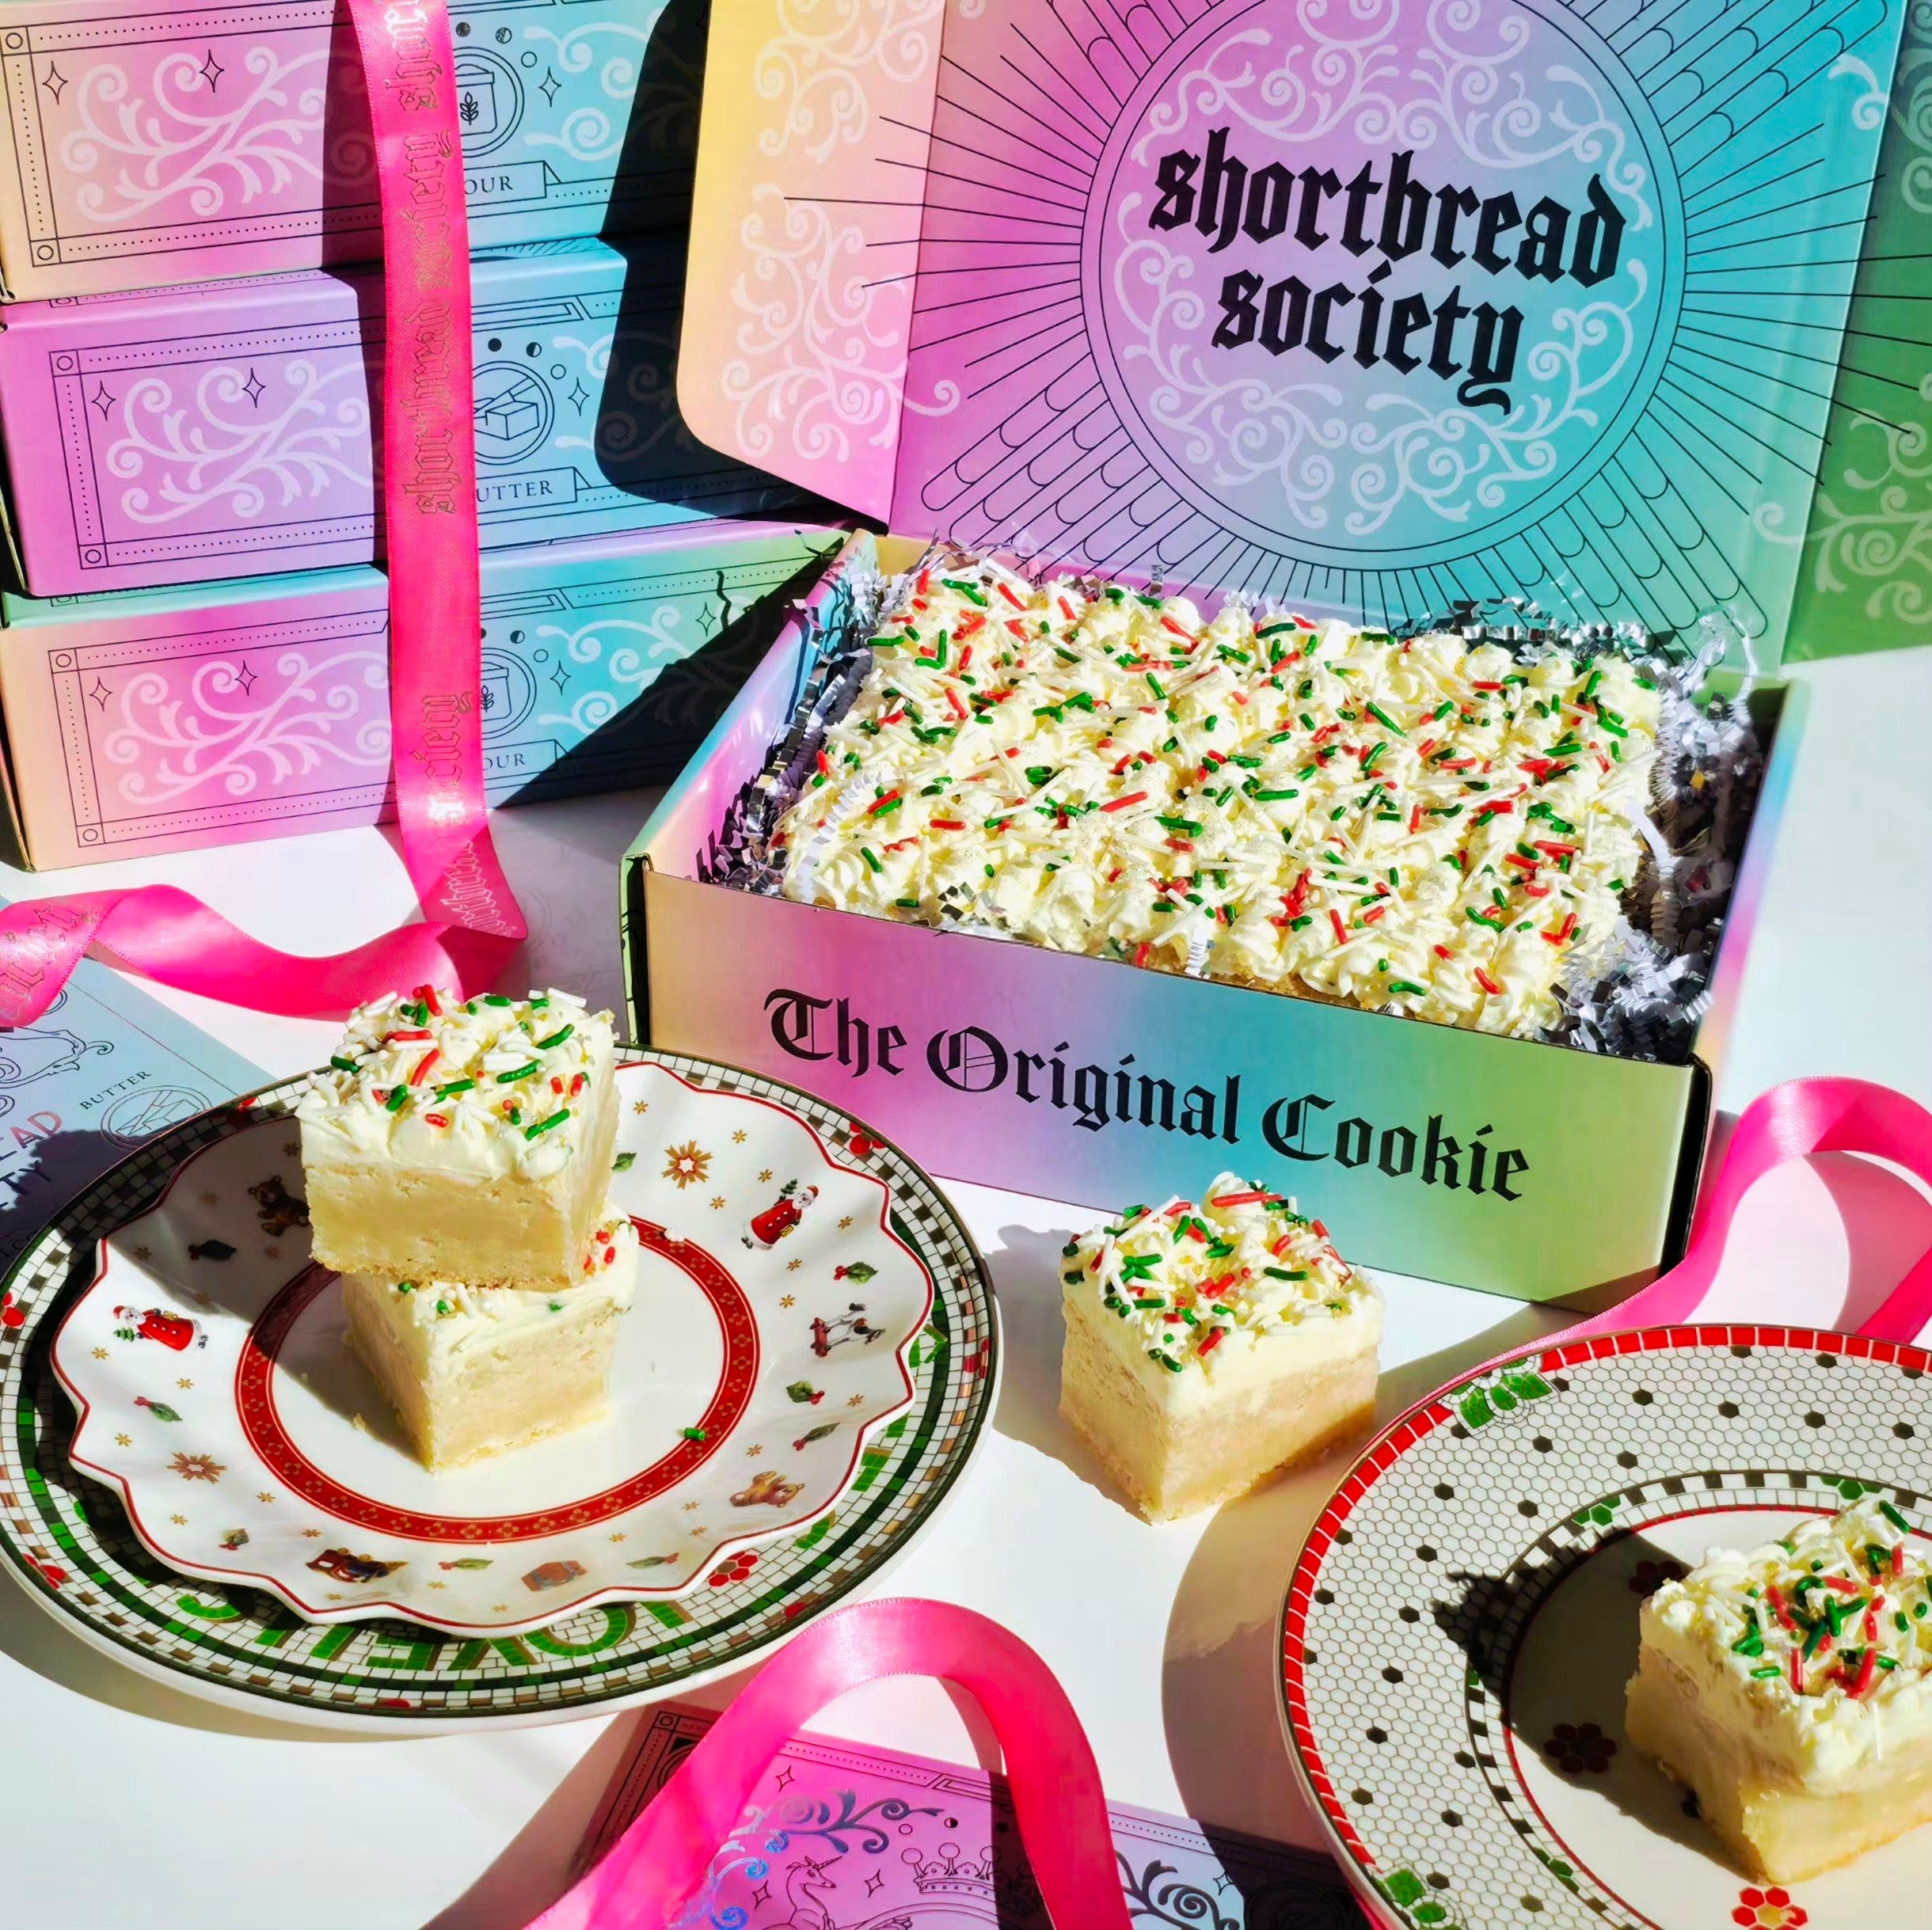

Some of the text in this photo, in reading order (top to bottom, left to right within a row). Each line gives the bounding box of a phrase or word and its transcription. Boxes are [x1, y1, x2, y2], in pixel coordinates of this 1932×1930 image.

[465, 175, 514, 196] OUR
[1148, 126, 1626, 288] shortbread
[1211, 258, 1524, 416] society
[476, 480, 553, 503] UTTER
[482, 753, 527, 771] OUR
[80, 1071, 152, 1109] BUTTER
[763, 987, 1530, 1202] The Original Cookie
